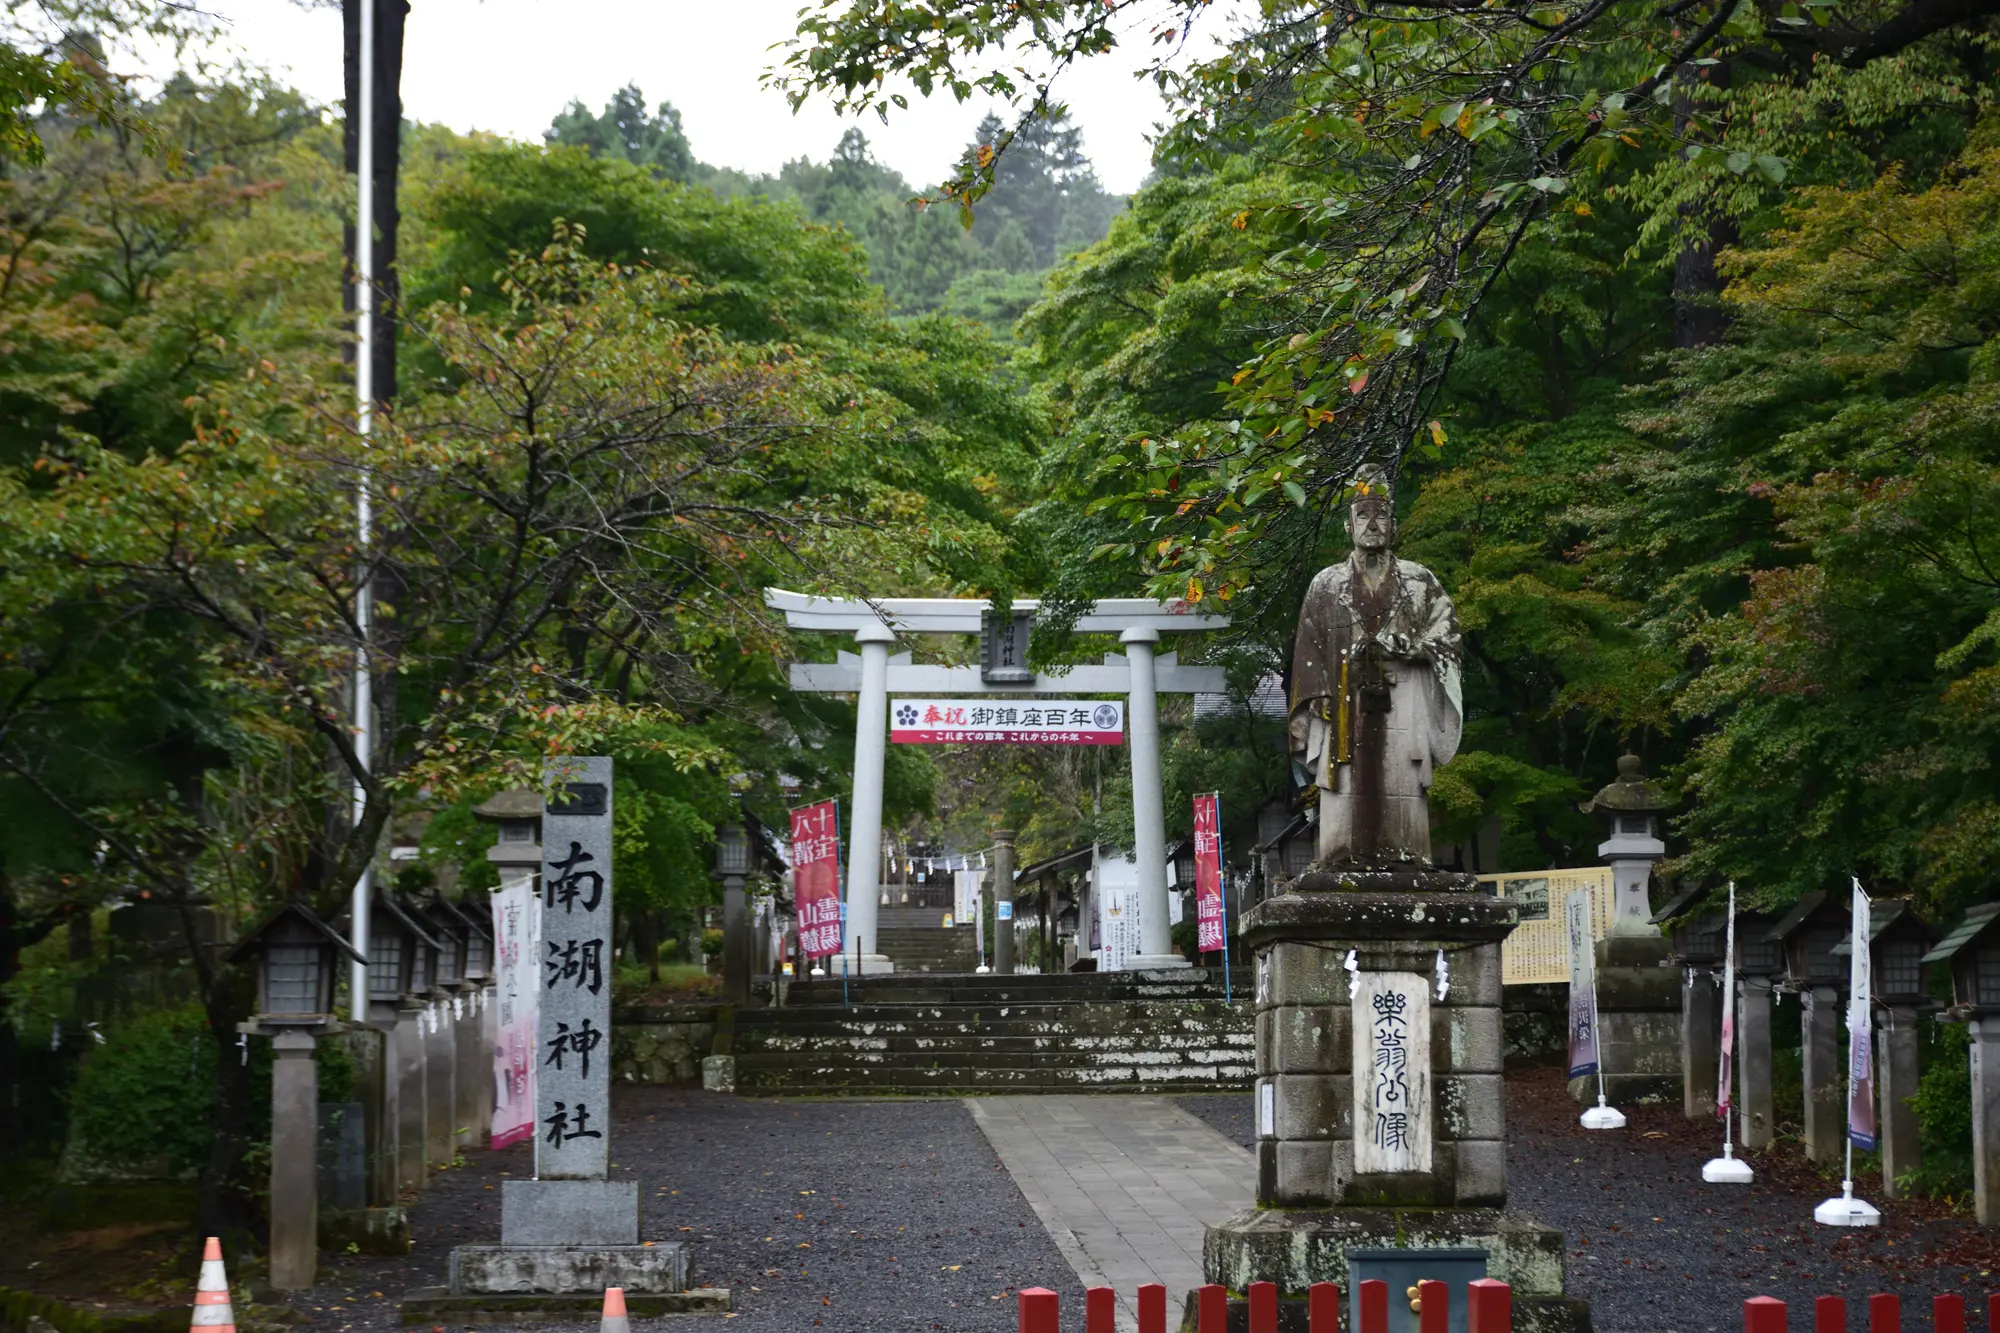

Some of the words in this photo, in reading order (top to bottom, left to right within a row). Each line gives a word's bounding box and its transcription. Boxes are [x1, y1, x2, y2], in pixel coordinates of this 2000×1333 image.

[923, 705, 967, 727] 奉祝
[971, 707, 1092, 728] 御鎮座百年
[936, 731, 1005, 741] これまでの百年
[1011, 732, 1080, 742] これからの千年
[545, 841, 605, 1150] 南湖神社
